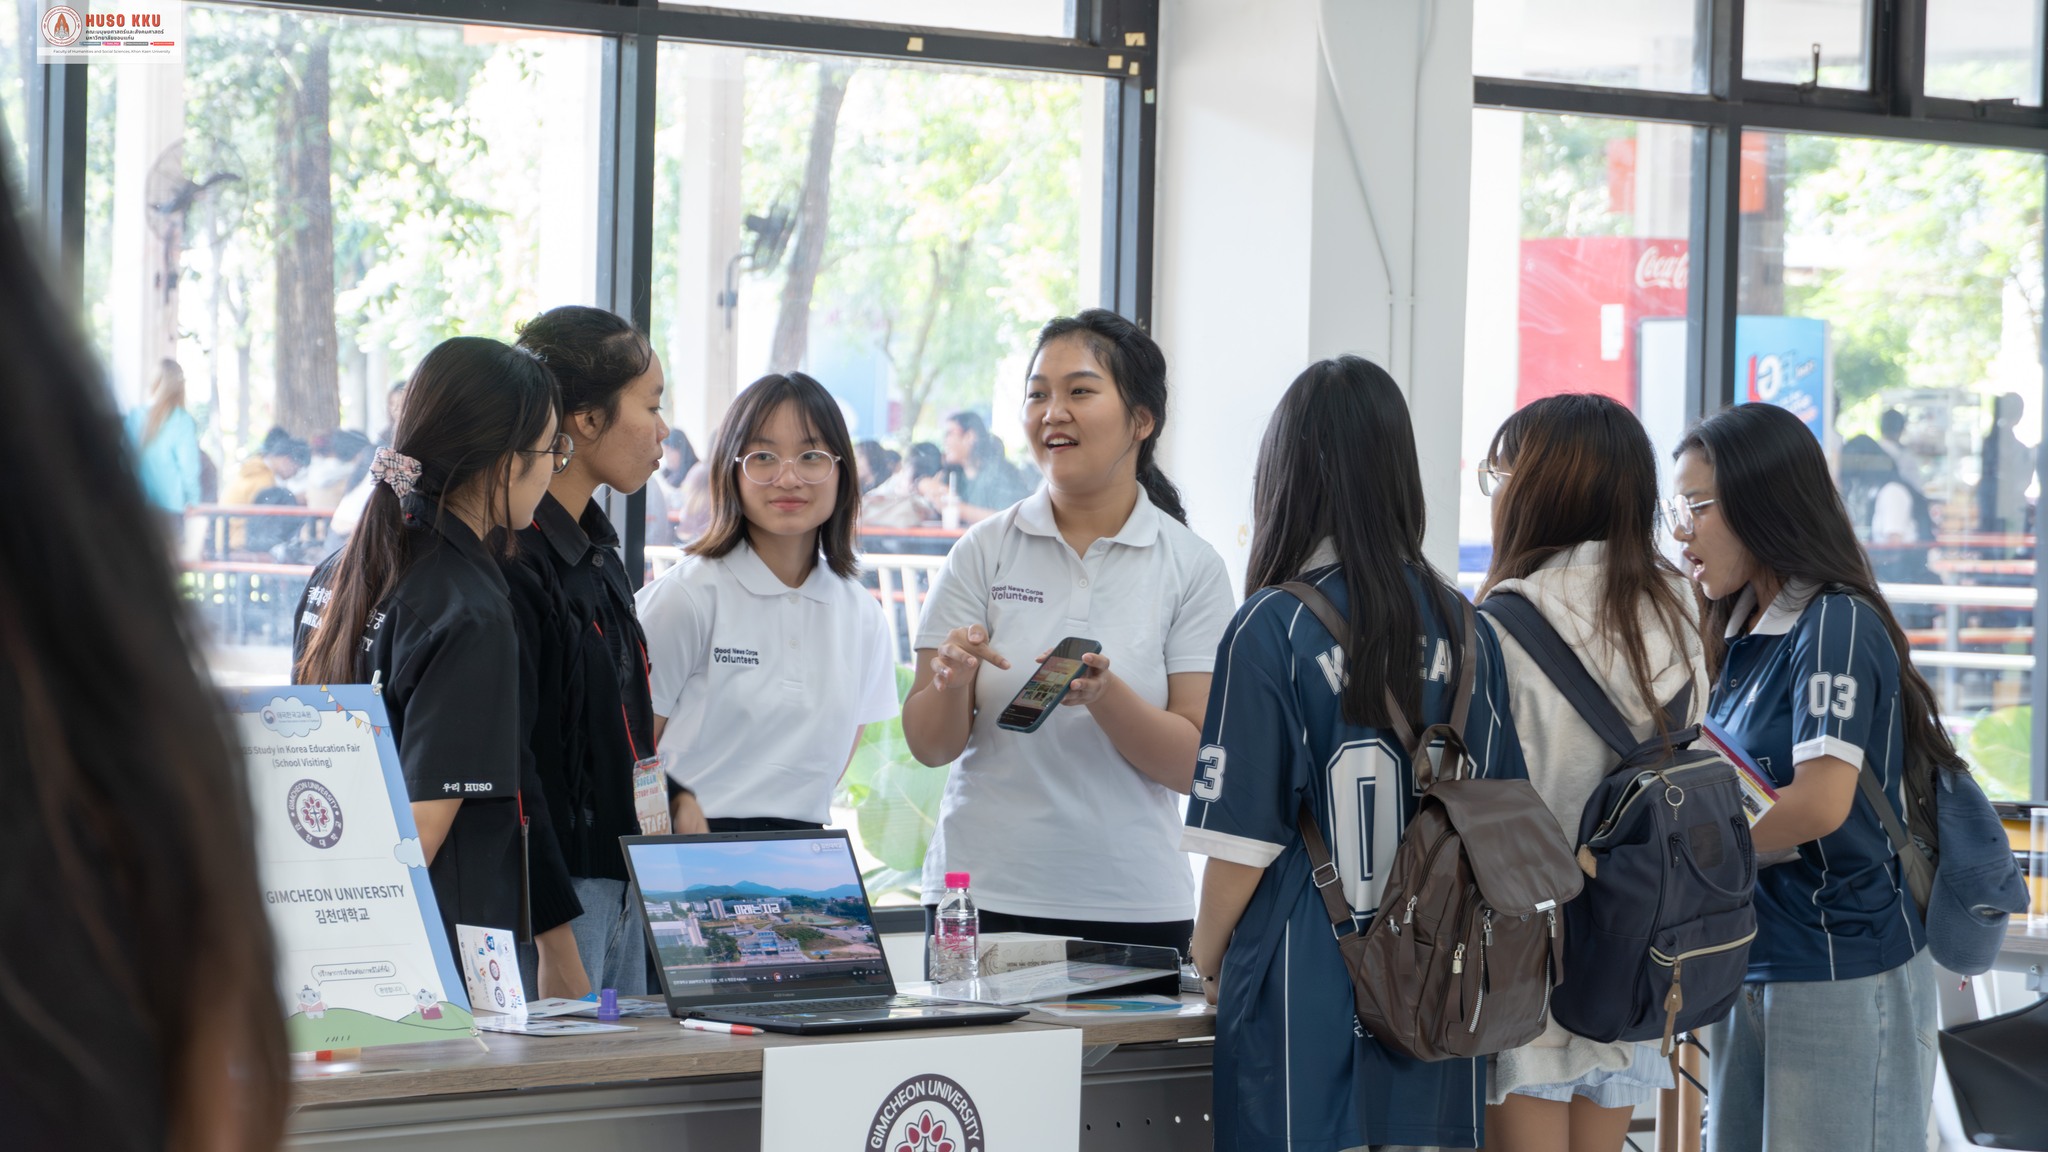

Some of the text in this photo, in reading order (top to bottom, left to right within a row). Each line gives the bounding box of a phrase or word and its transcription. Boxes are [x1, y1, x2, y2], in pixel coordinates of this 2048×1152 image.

[1008, 585, 1024, 593] News
[991, 591, 1044, 604] Volunteers
[714, 653, 760, 665] Volunteers
[1808, 671, 1858, 721] 03
[252, 746, 276, 756] Study
[277, 745, 285, 754] in
[286, 745, 308, 754] Korea
[309, 744, 346, 753] Education
[346, 743, 360, 752] Fair
[272, 757, 332, 769] (School Visiting)
[442, 782, 493, 793] 우리 HUSO
[641, 812, 667, 836] STAFF
[266, 885, 405, 905] GIMCHEON UNIVERSITY
[315, 907, 371, 925] 김천대학교
[870, 1080, 980, 1149] GIMCHEON UNIVERSITY
